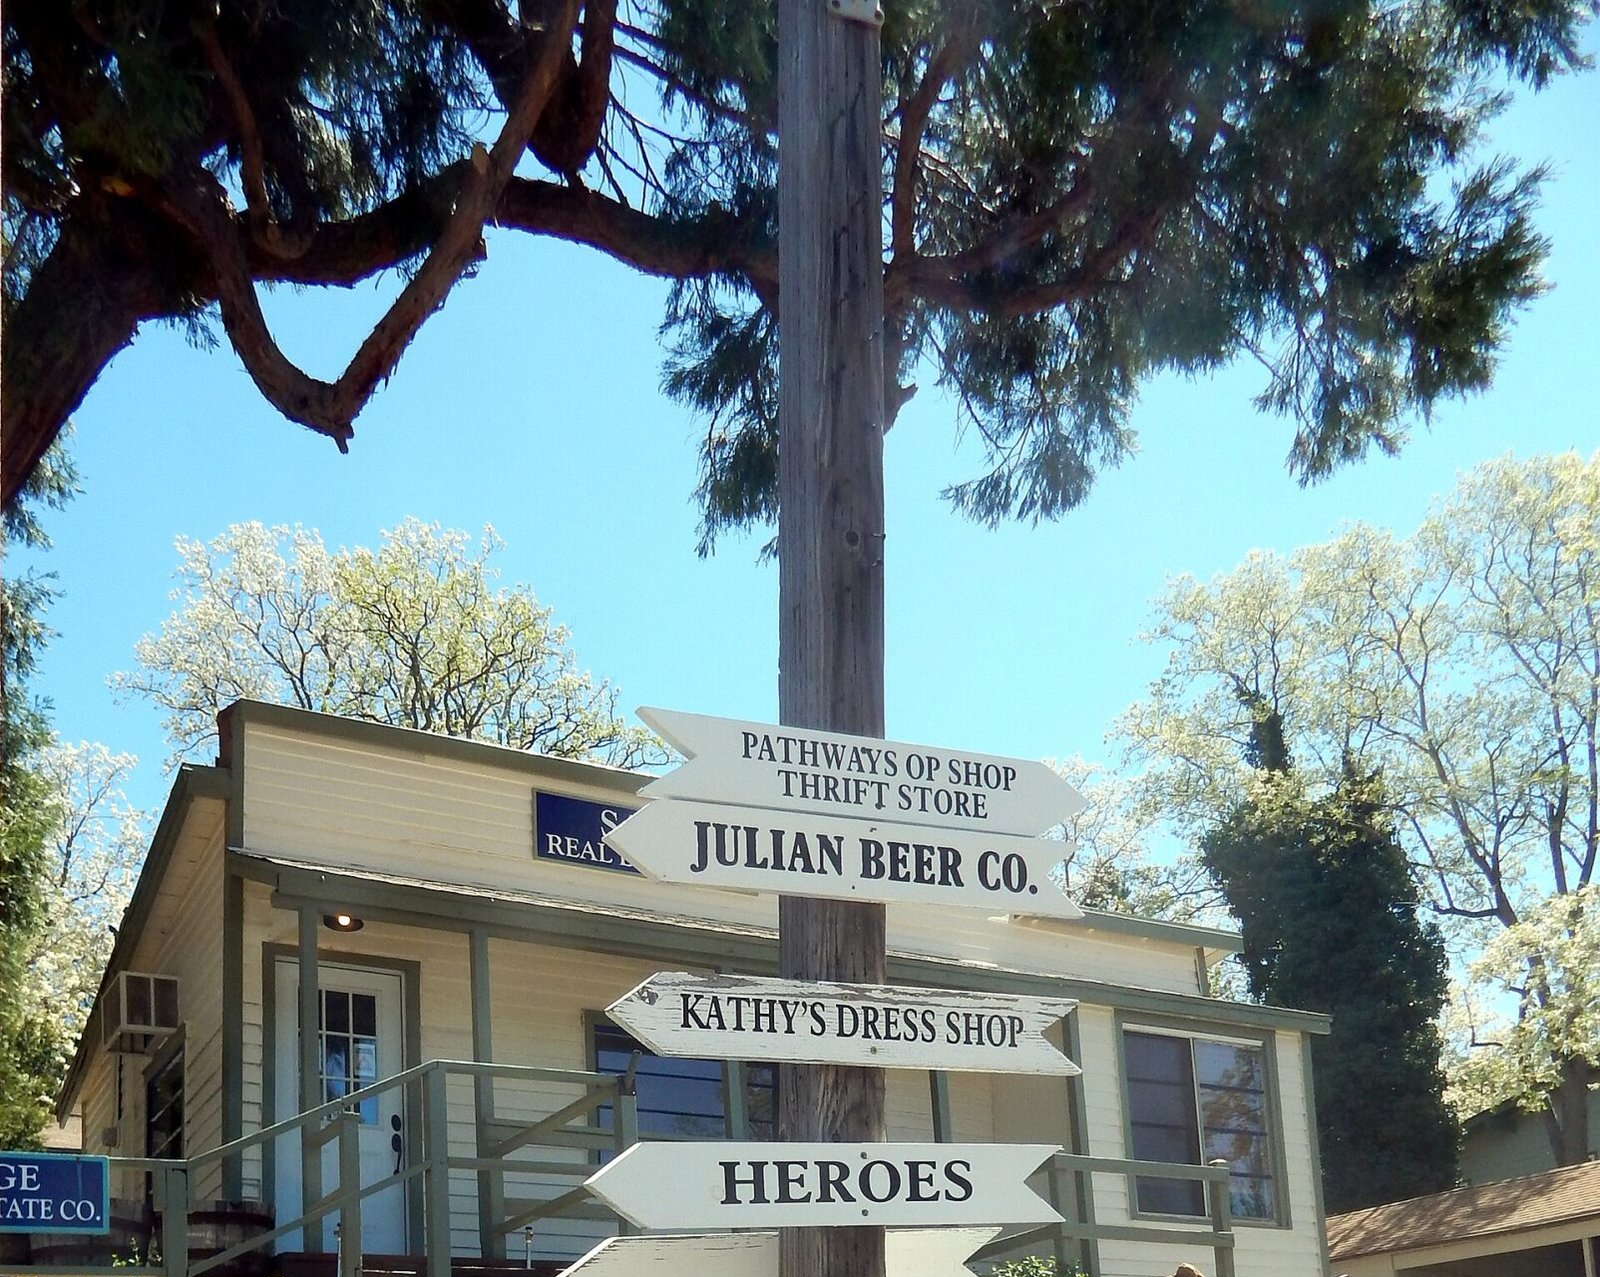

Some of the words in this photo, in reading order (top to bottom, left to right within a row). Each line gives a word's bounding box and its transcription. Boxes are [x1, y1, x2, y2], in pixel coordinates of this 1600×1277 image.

[742, 731, 897, 777] PATHWAYS
[906, 754, 940, 781] OP
[949, 759, 1016, 791] SHOP
[777, 769, 890, 806] THRIFT
[899, 785, 987, 818] STORE
[546, 833, 613, 864] REAL
[690, 821, 844, 875] JULIAN
[859, 838, 964, 887] BEER
[978, 851, 1037, 894] CO.
[680, 993, 825, 1036] KATHY'S
[836, 1004, 936, 1042] DRESS
[946, 1011, 1023, 1047] SHOP
[719, 1160, 972, 1204] HEROES
[60, 1200, 101, 1221] CO.
